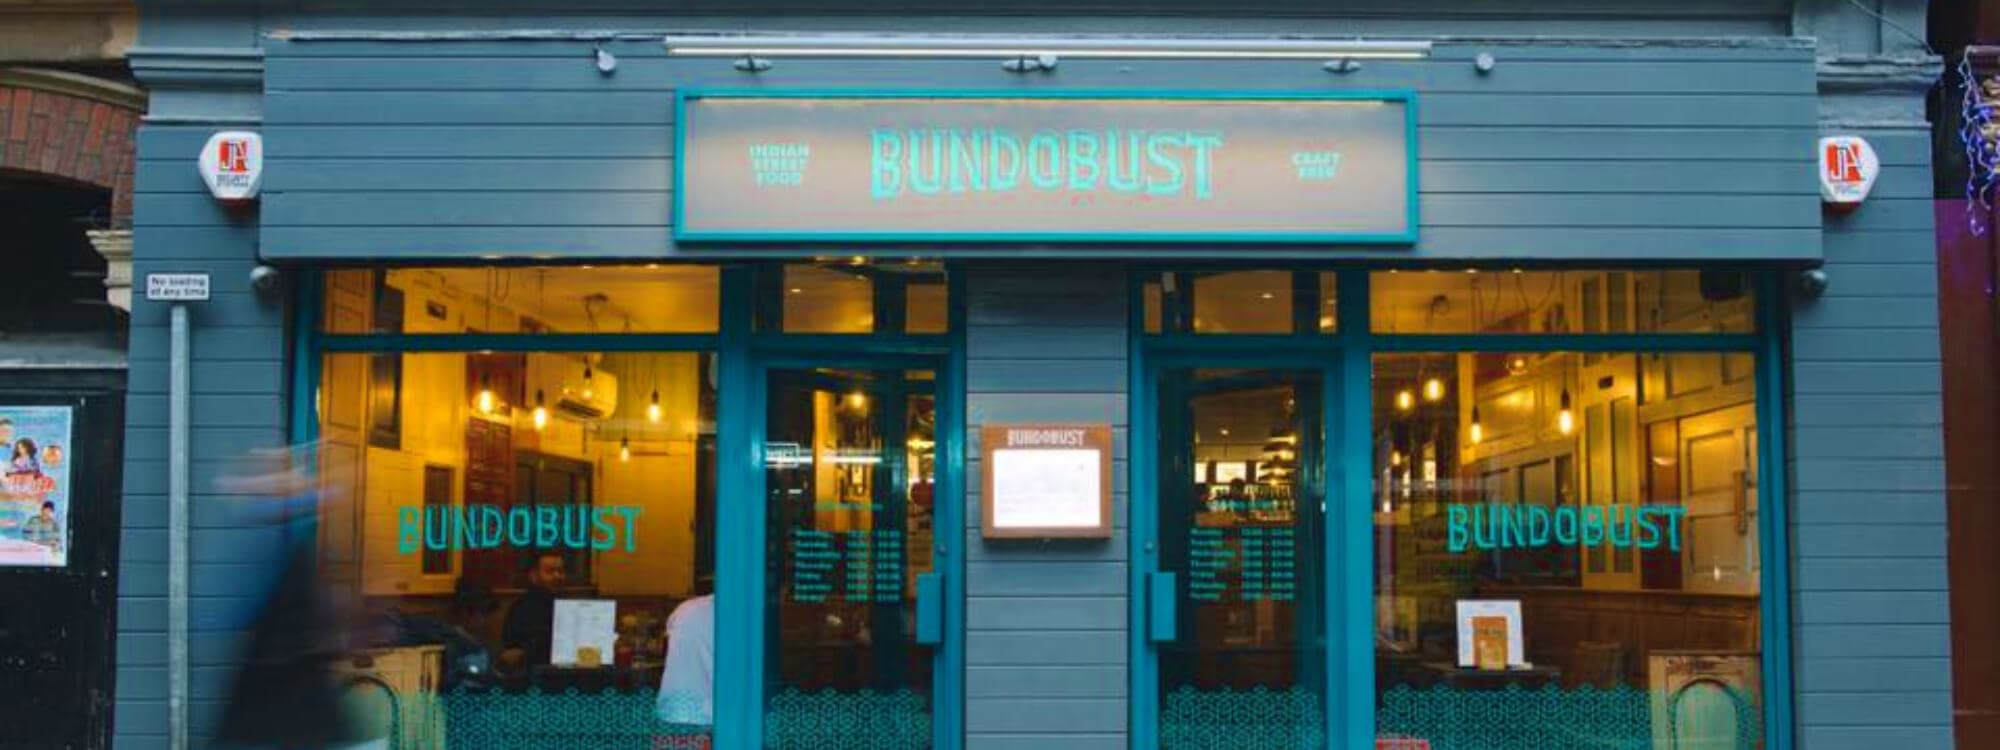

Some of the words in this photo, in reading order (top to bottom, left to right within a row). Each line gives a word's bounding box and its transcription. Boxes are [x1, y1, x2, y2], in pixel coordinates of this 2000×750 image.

[748, 145, 809, 158] INDIAN
[870, 128, 1223, 199] BUNDOBUST
[756, 172, 801, 186] FOOD
[151, 277, 167, 286] No
[398, 504, 642, 555] BUNDOBUST
[1446, 503, 1686, 553] BUNDOBUST
